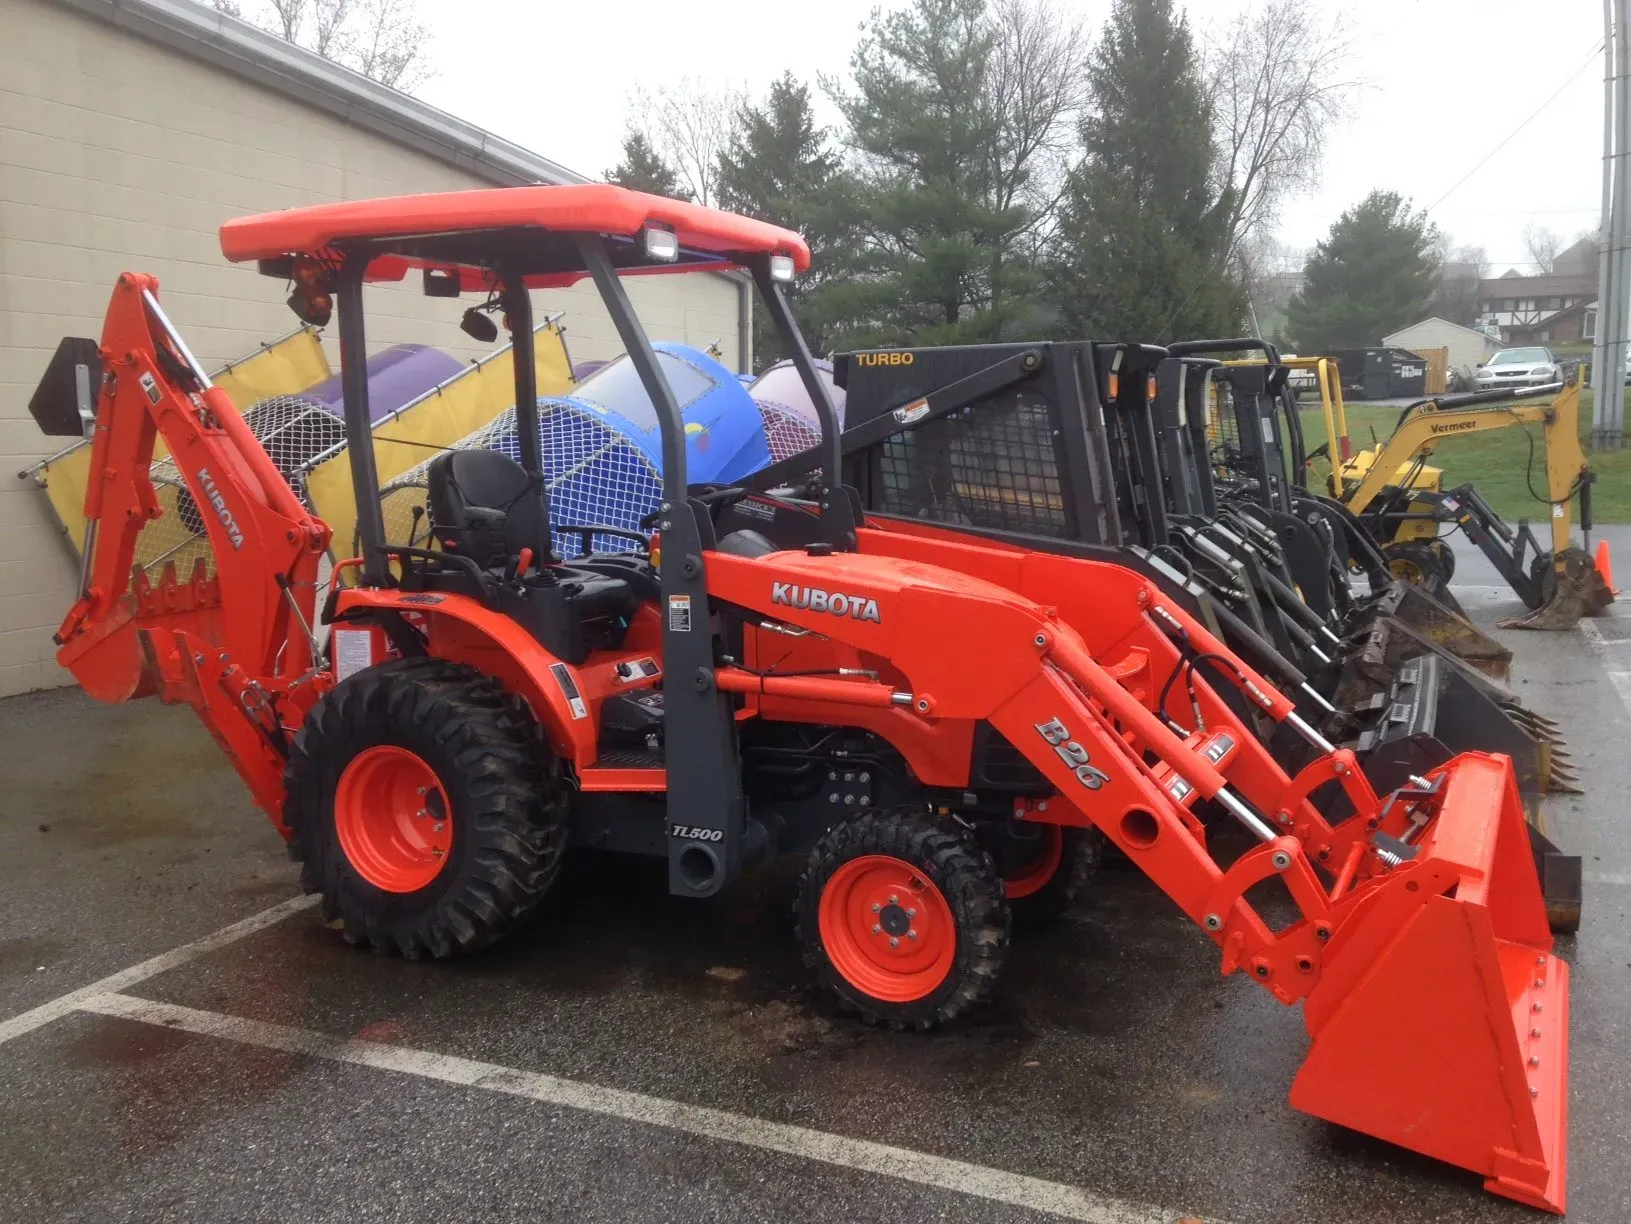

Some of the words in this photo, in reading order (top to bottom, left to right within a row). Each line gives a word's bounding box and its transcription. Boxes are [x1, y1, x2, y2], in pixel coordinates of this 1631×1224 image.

[855, 352, 914, 366] TURBO
[1430, 420, 1477, 434] Vermeer
[196, 467, 244, 551] KUBOTA
[771, 581, 882, 624] KUBOTA
[1033, 716, 1111, 790] B26
[672, 825, 724, 842] TL500
